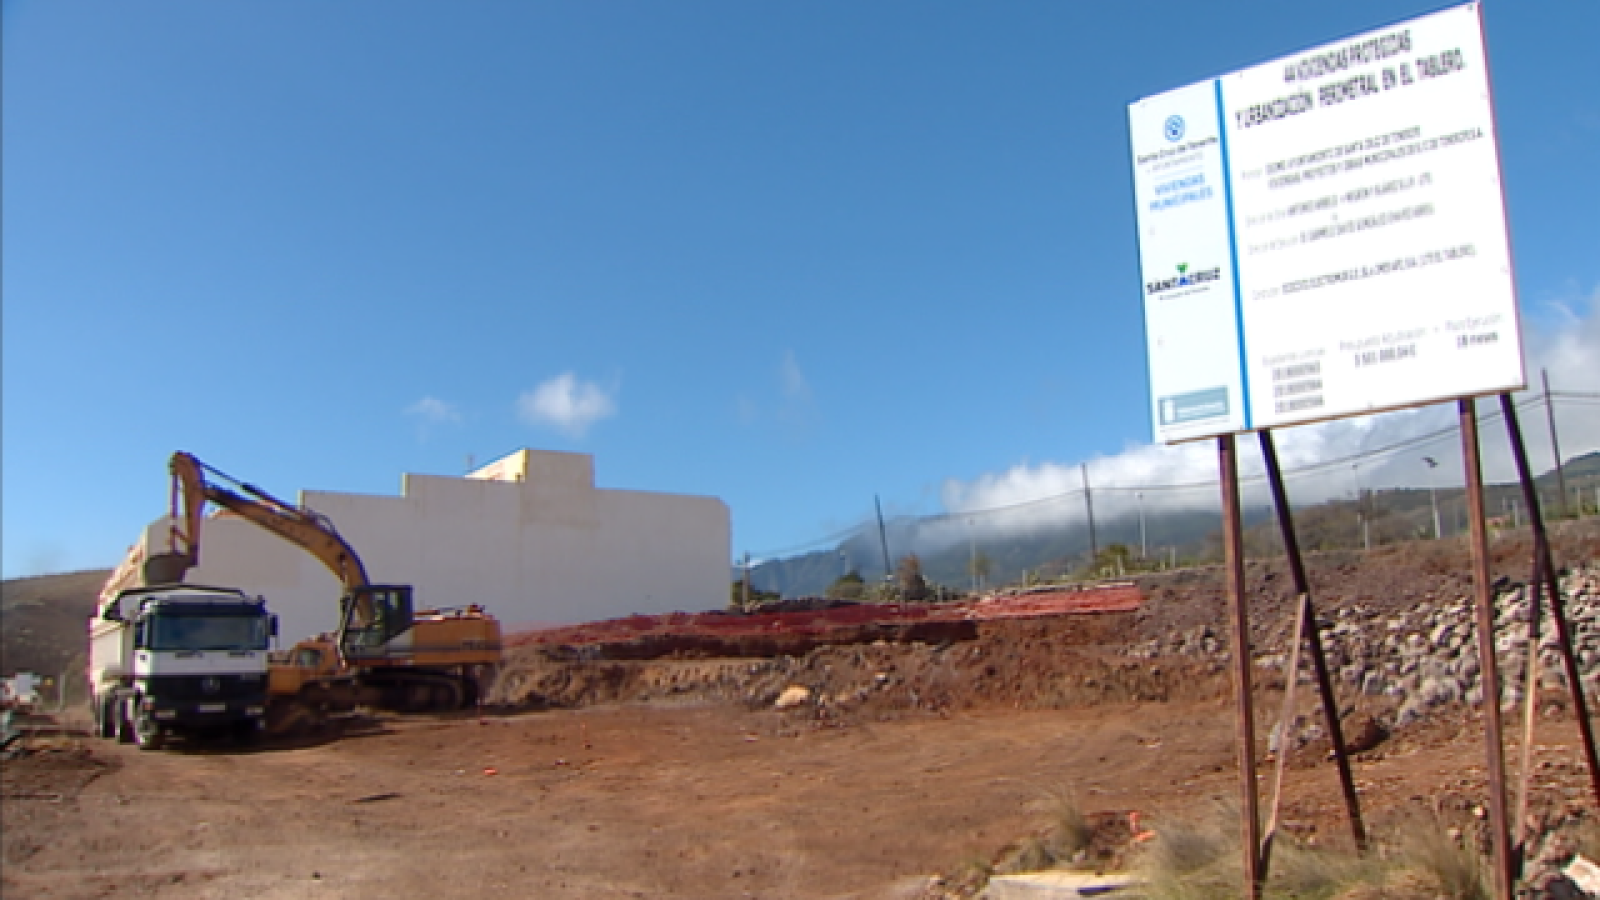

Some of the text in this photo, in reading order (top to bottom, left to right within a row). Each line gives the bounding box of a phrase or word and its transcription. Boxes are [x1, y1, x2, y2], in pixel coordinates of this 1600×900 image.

[1235, 106, 1243, 131] Y
[1381, 65, 1398, 92] EN
[1400, 61, 1413, 87] EL
